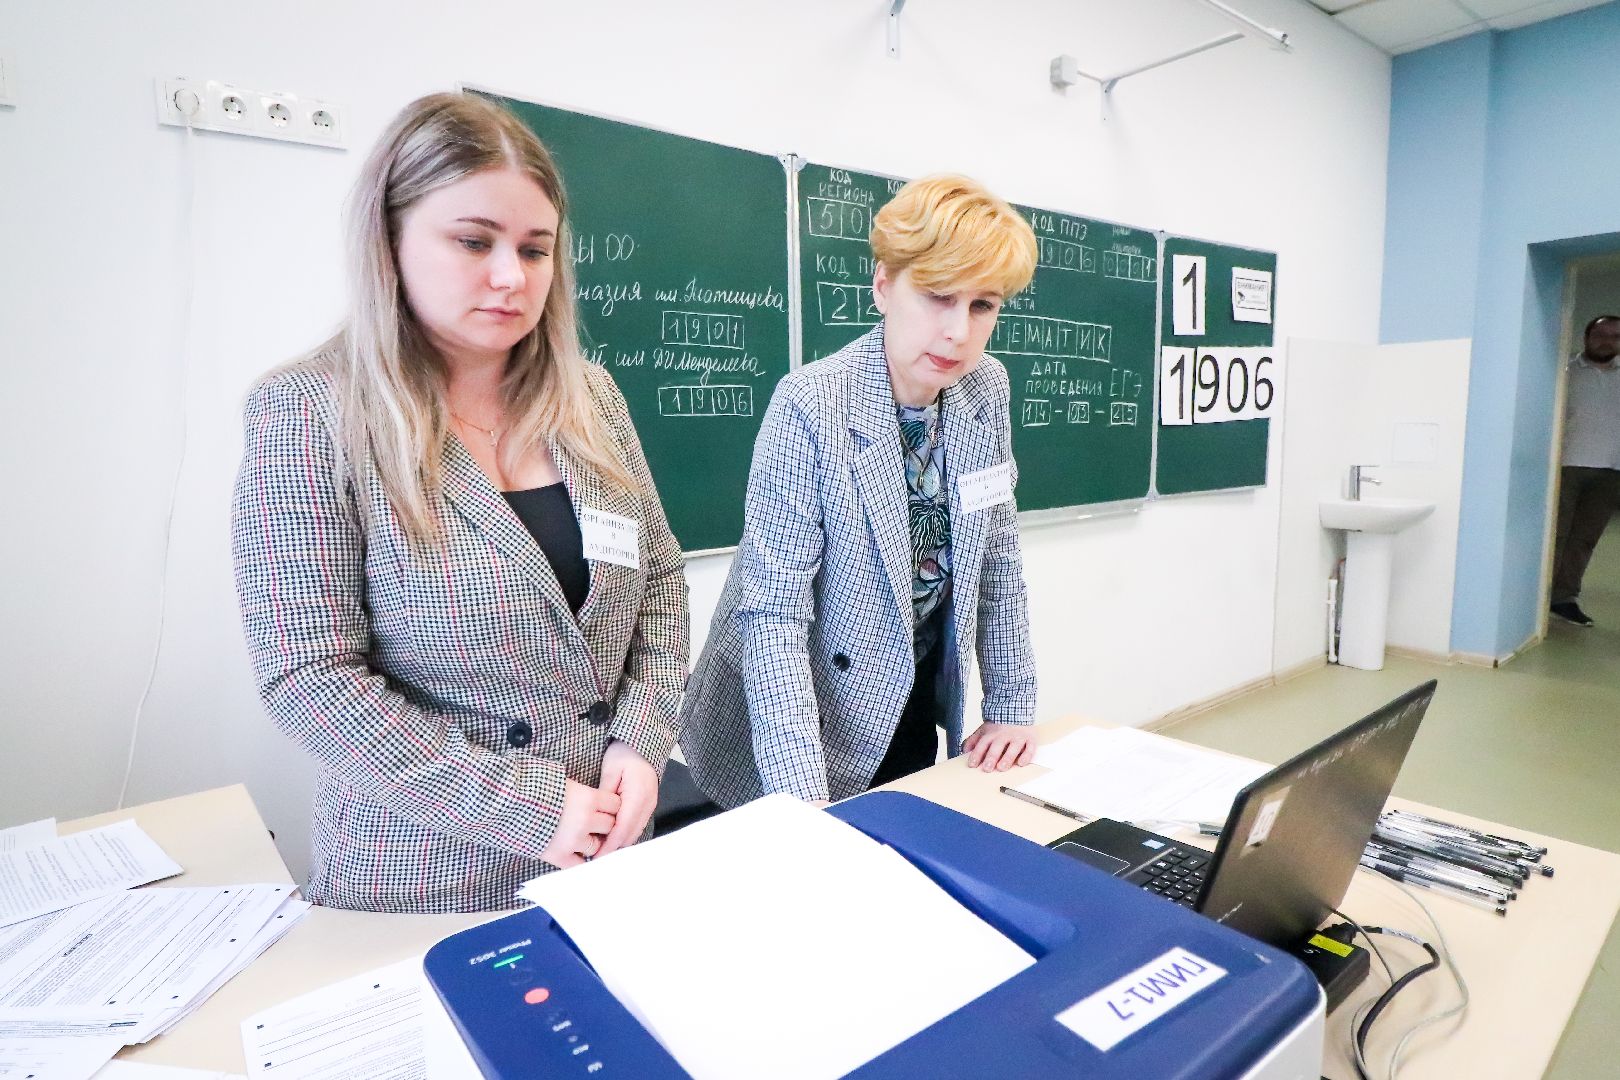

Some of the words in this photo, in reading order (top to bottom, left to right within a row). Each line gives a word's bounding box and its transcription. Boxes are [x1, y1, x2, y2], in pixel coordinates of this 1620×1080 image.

[829, 168, 852, 185] КОД
[887, 179, 903, 195] КО
[819, 183, 875, 203] РЕГИОНА
[820, 203, 863, 234] 50
[1031, 212, 1055, 232] КОД
[1060, 219, 1087, 240] ППЭ
[816, 253, 850, 280] КОД
[1046, 244, 1092, 267] 906
[577, 281, 642, 317] назия
[1001, 297, 1035, 312] МЕТА
[1181, 262, 1197, 330] 1
[668, 318, 738, 345] 1901
[996, 320, 1106, 352] ТЕМАТИК
[1031, 361, 1067, 376] ДАТА
[1026, 379, 1103, 397] ПРОВЕДЕНИЯ
[1109, 368, 1142, 398] ЕГЭ
[672, 387, 748, 413] 1906
